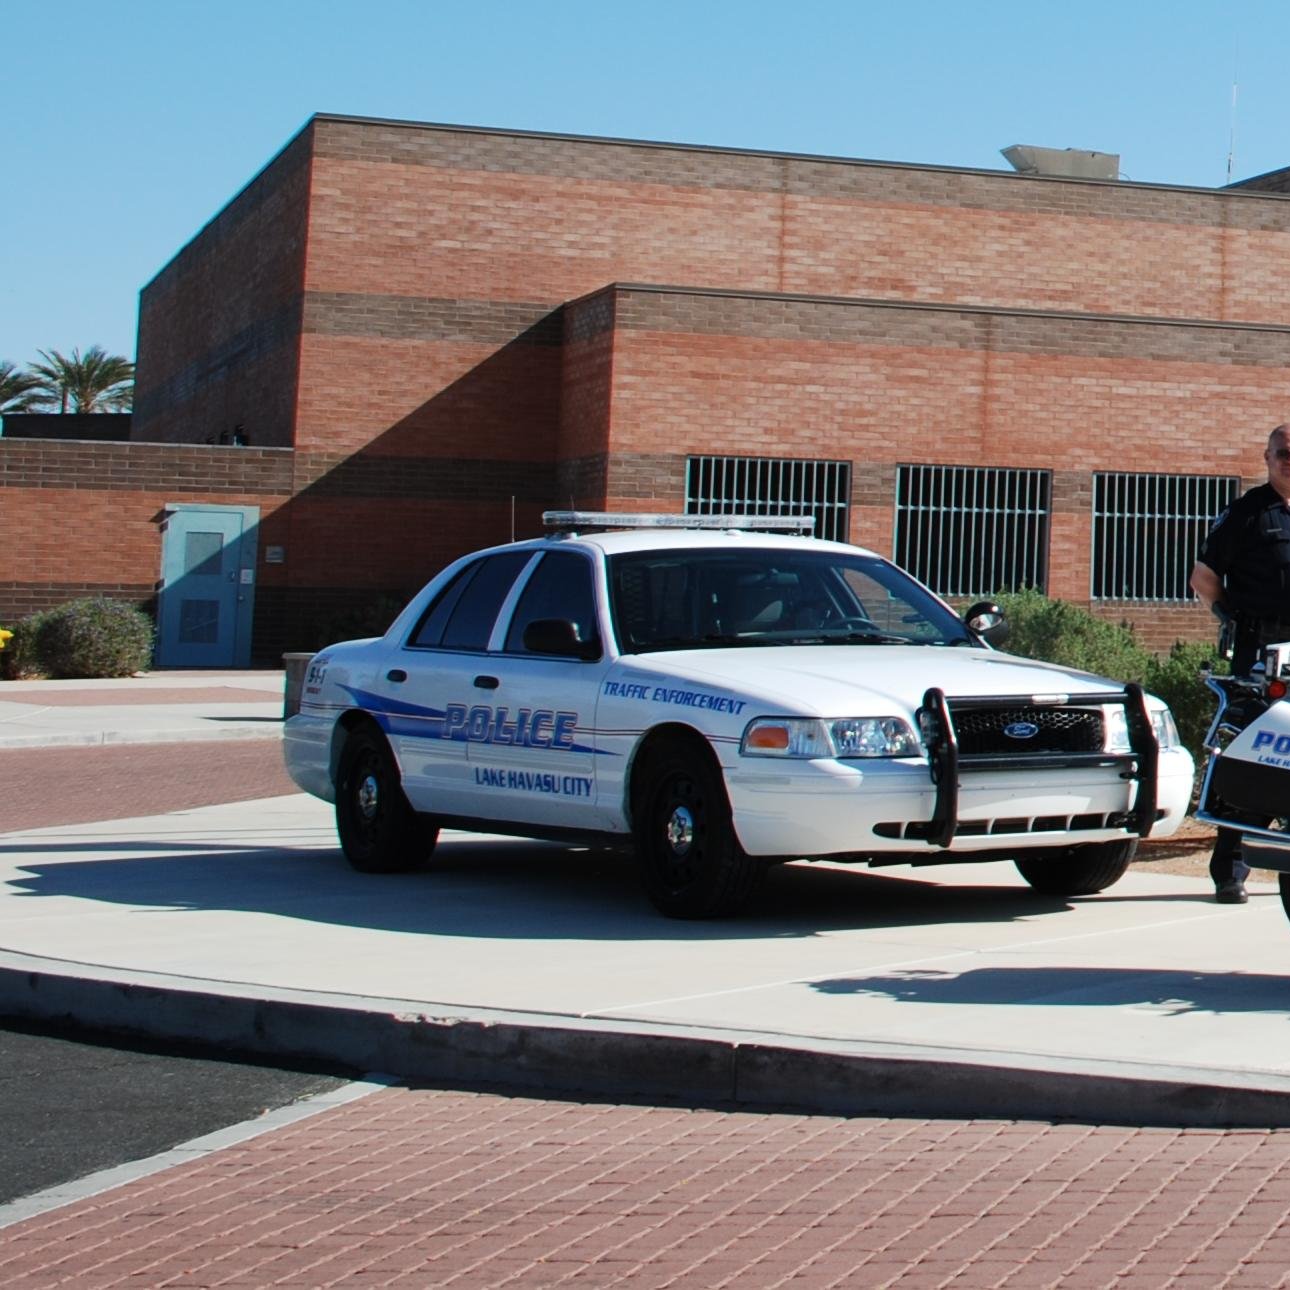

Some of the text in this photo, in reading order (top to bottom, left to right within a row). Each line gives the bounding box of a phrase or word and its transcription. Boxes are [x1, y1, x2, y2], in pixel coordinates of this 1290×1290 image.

[603, 681, 747, 716] TRAFFIC ENFORCEMENT
[442, 703, 578, 750] POLICE
[1257, 755, 1281, 765] LAKE
[475, 767, 594, 797] LAKE HAVASU CITY
